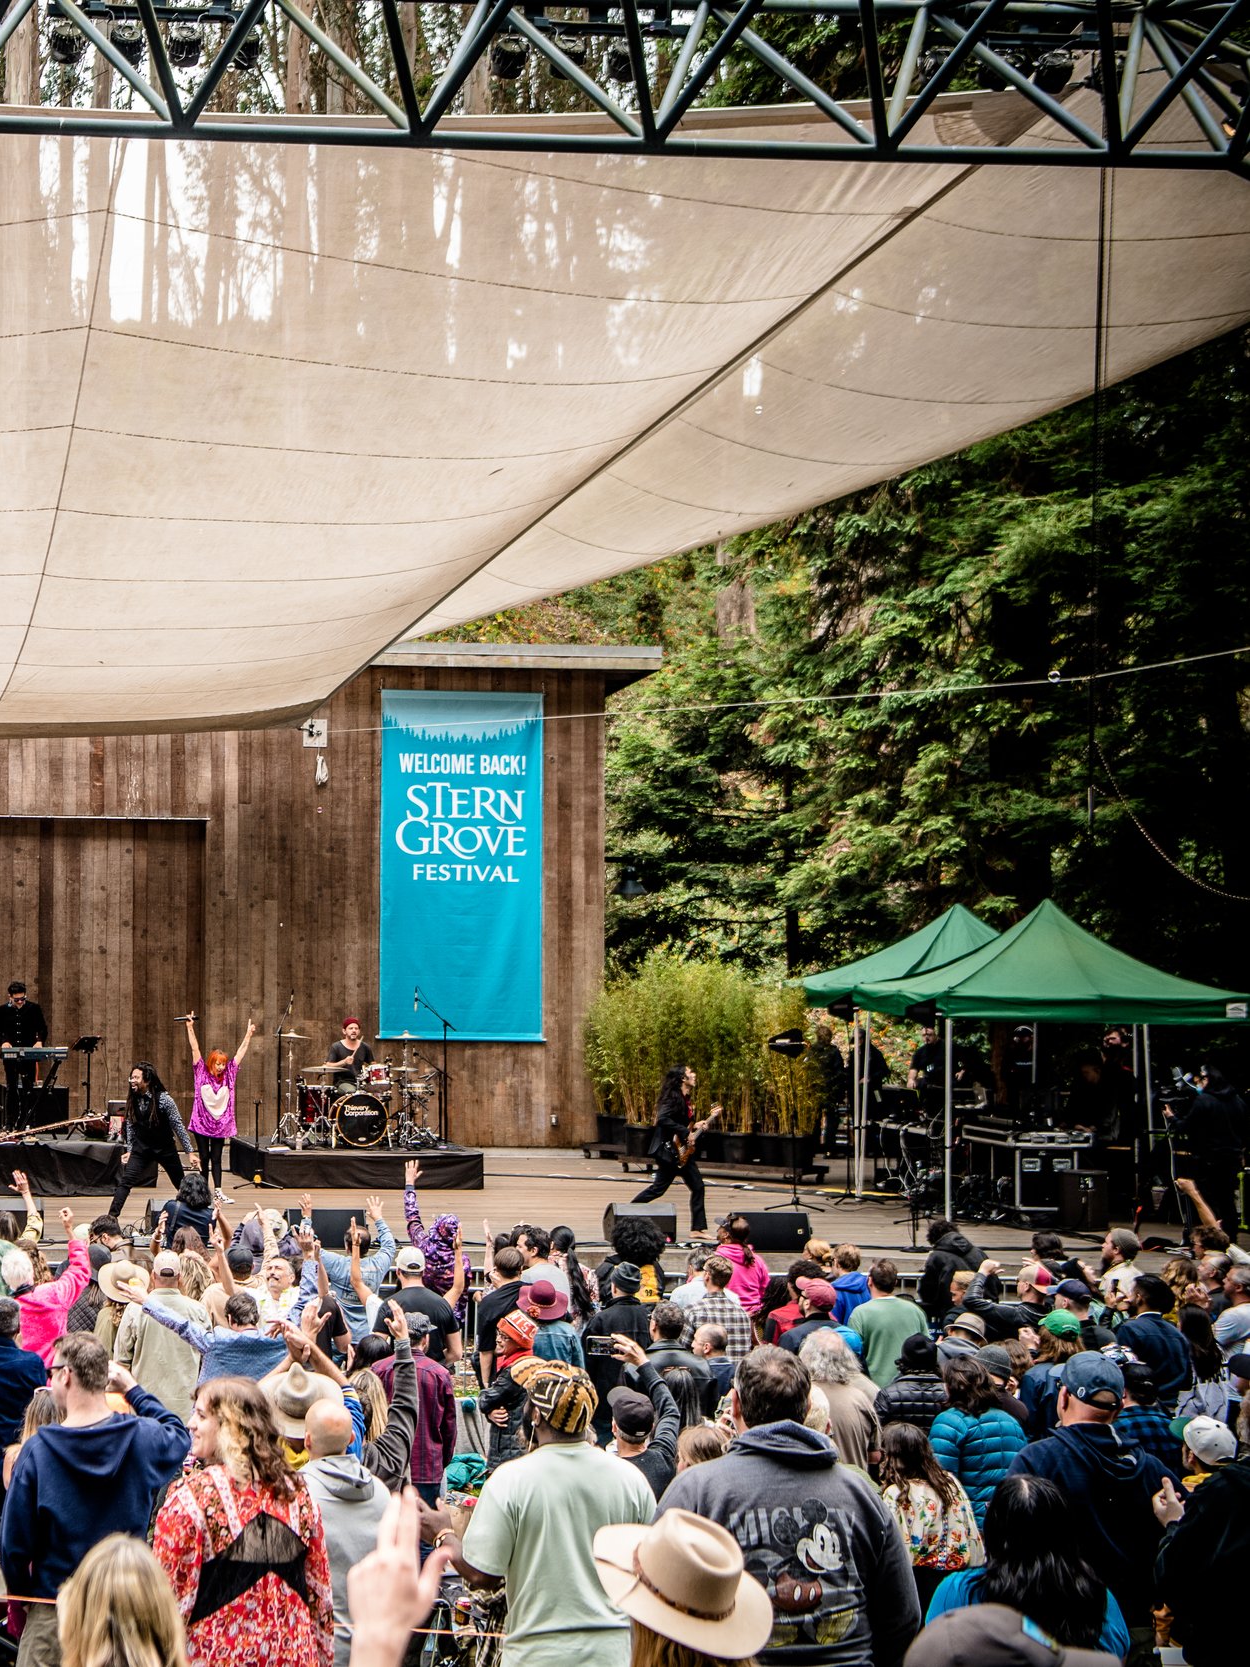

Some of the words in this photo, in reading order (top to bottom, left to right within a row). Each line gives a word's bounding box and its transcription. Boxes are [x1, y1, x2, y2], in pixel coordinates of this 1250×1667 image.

[399, 753, 475, 775] WELCOME
[480, 755, 526, 775] BACK!
[406, 782, 525, 825] STERN
[395, 817, 527, 860] GROVE
[412, 863, 520, 883] FESTIVAL
[344, 1104, 369, 1112] Thievery
